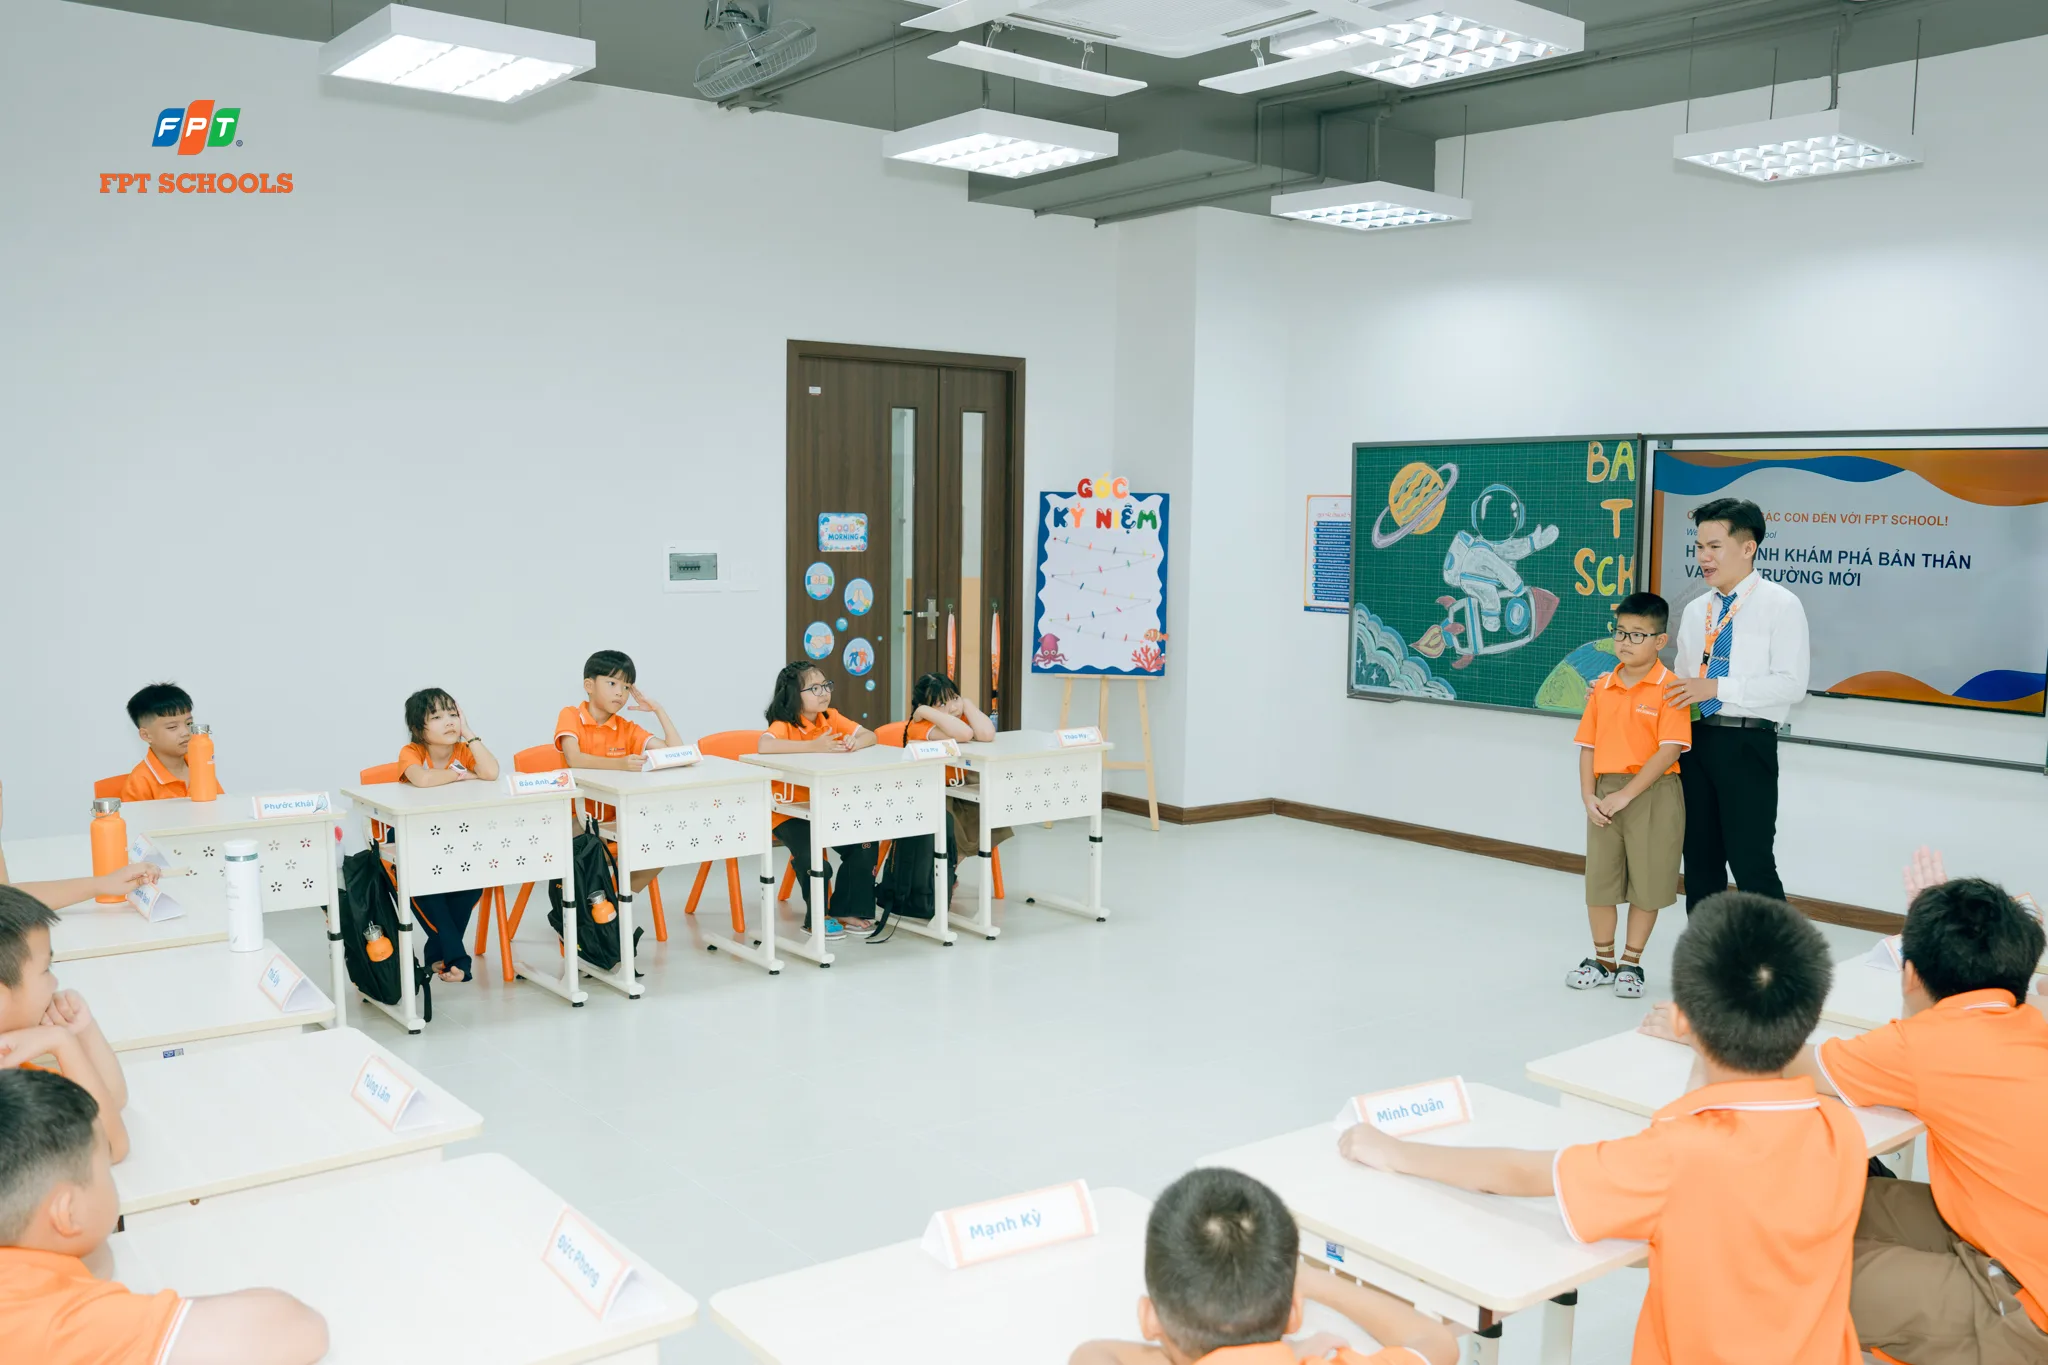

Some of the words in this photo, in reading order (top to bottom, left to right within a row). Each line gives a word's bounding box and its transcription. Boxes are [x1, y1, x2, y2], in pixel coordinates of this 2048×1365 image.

[1077, 472, 1129, 499] GÓC
[1096, 503, 1157, 534] NIỆM
[1761, 510, 1781, 522] ÁC
[1784, 512, 1809, 523] CON
[1865, 514, 1888, 525] FPT
[1891, 514, 1949, 527] SCHOOL!
[828, 533, 859, 541] MORNING
[1785, 545, 1833, 564] KHÁM
[1838, 547, 1873, 566] PHÁ
[1879, 548, 1916, 567] BẢN
[1922, 550, 1971, 570] THÂN
[1757, 566, 1823, 585] RƯỜNG
[1829, 568, 1861, 587] MỚI
[1376, 1104, 1410, 1123] Minh
[1410, 1097, 1445, 1117] Quân
[968, 1216, 1018, 1240] Mạnh
[573, 1249, 600, 1288] Phong
